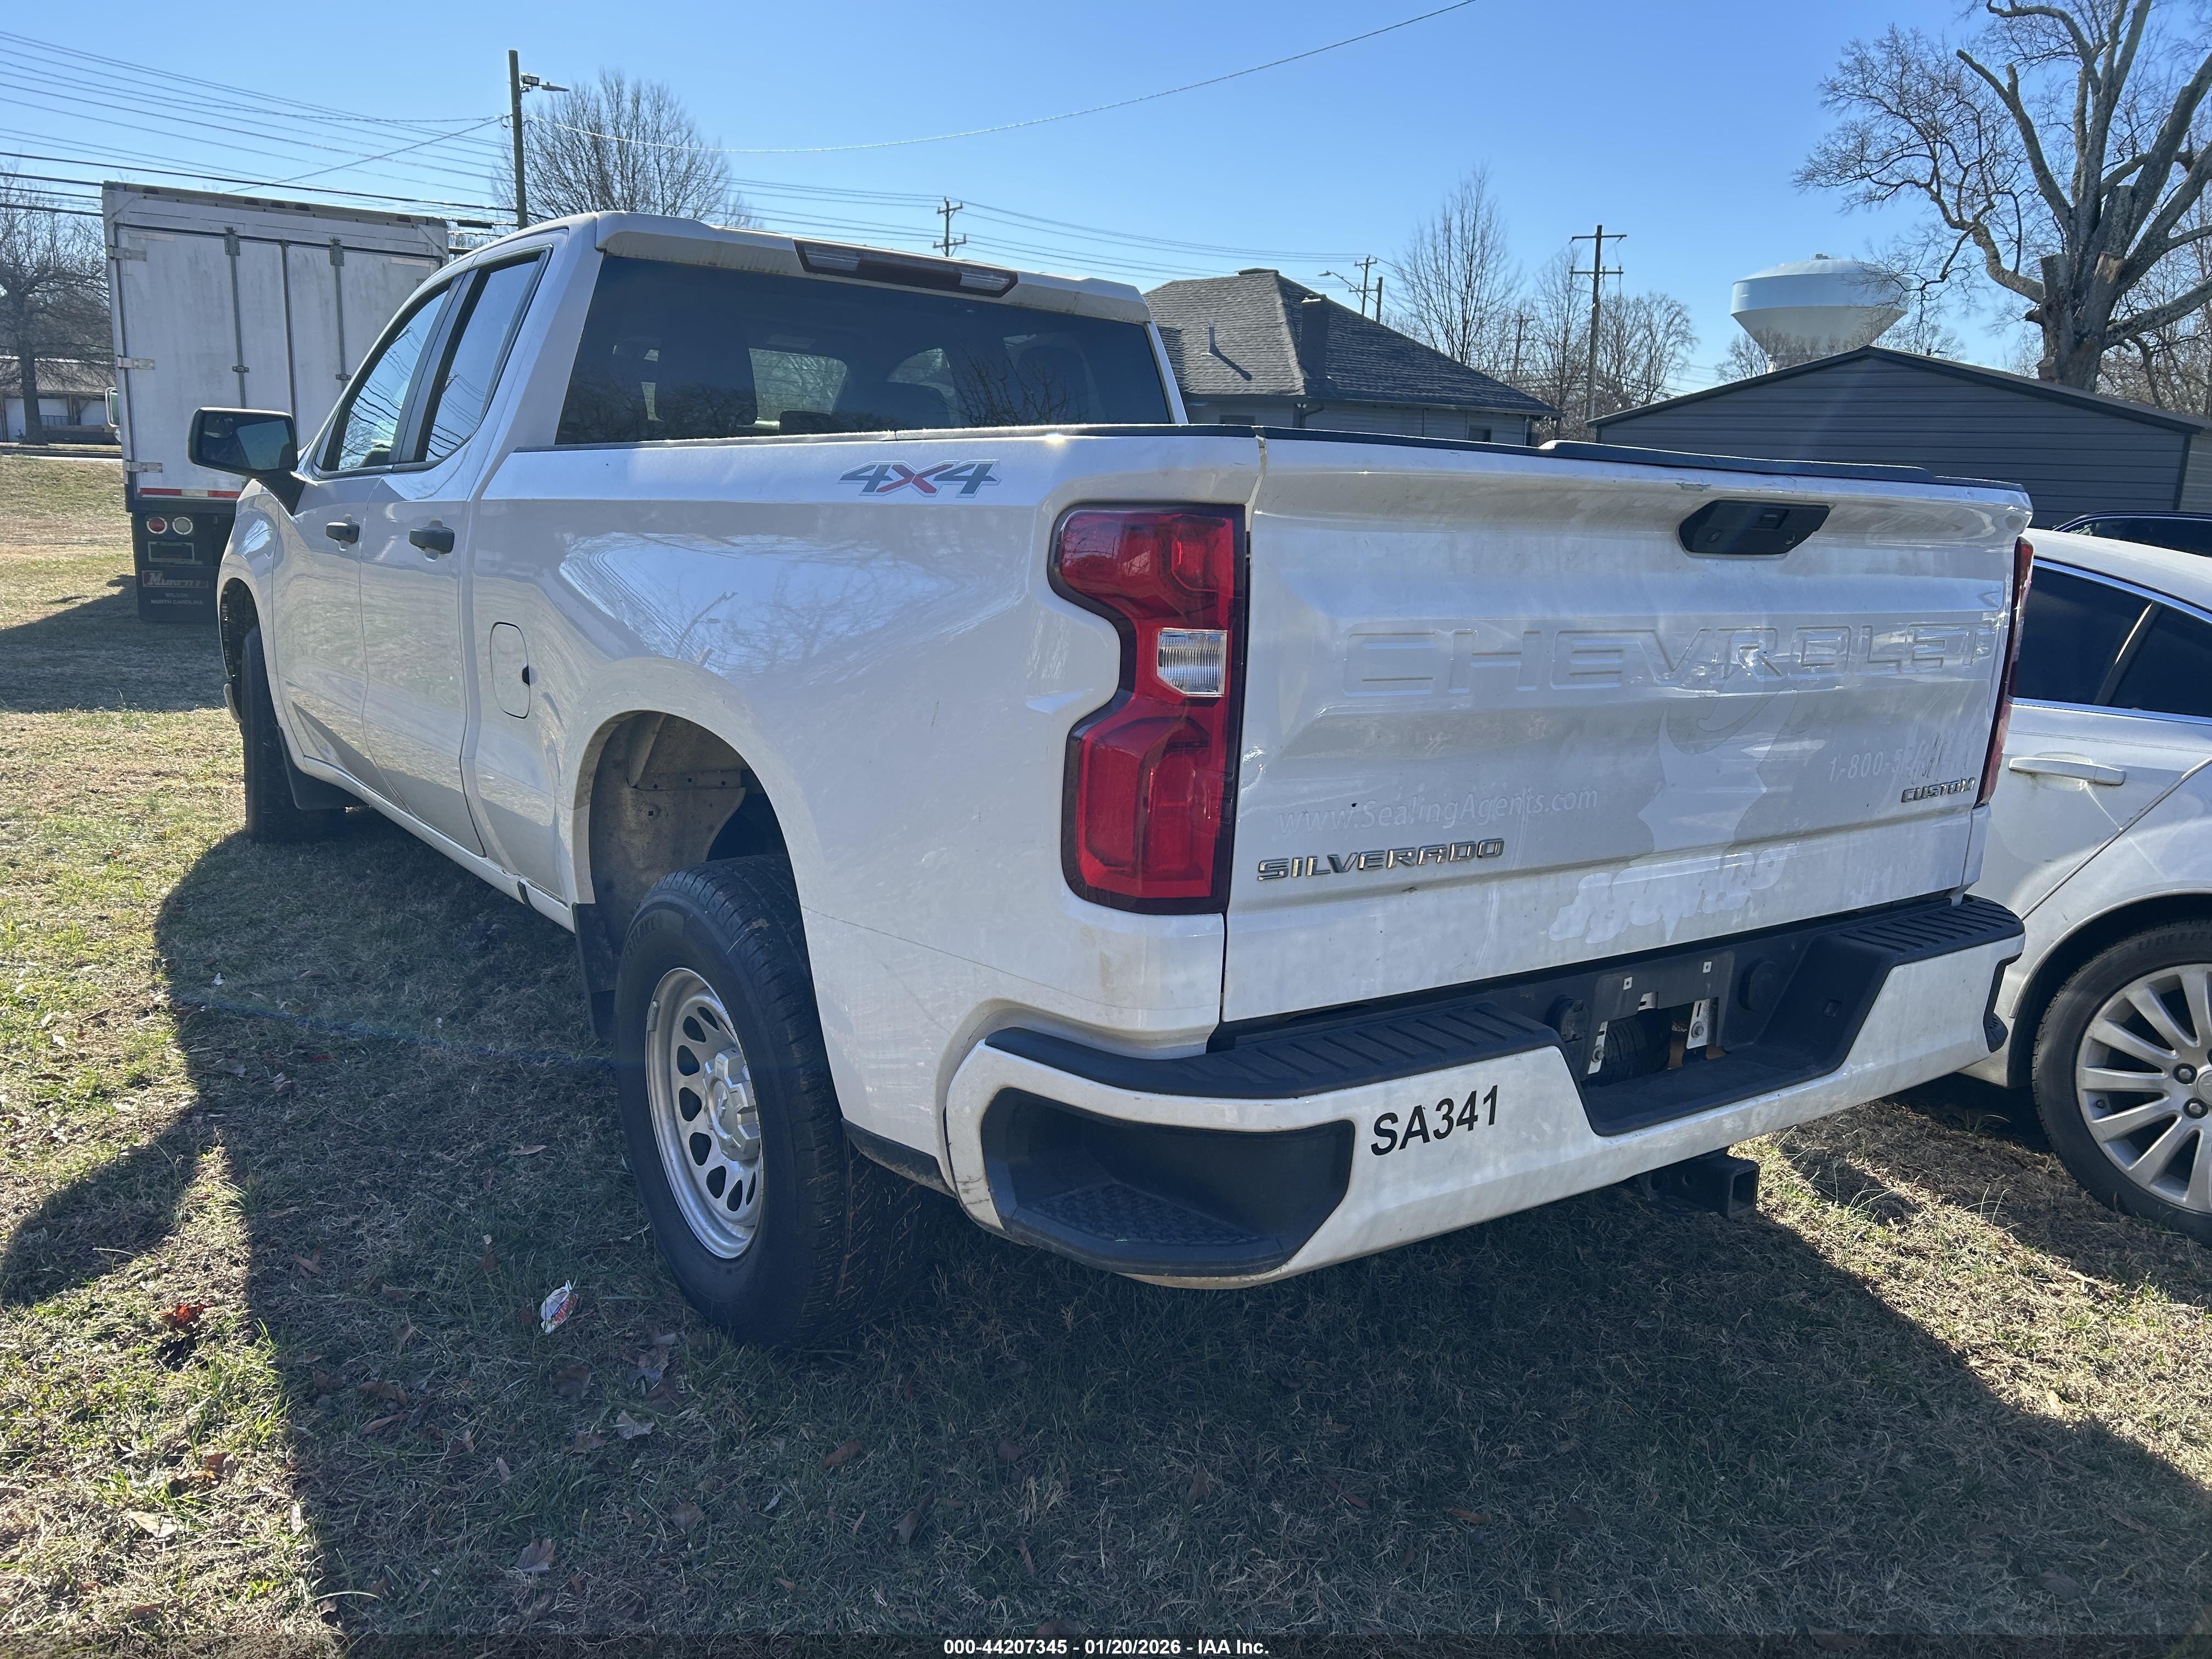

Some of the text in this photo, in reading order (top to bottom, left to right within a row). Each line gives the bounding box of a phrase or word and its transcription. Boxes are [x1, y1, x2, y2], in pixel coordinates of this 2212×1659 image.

[1342, 622, 1994, 698] CHEVROLET
[1901, 776, 1976, 803] CUSTOM
[1257, 837, 1505, 881] SILVERADO
[1370, 1084, 1498, 1156] SA341
